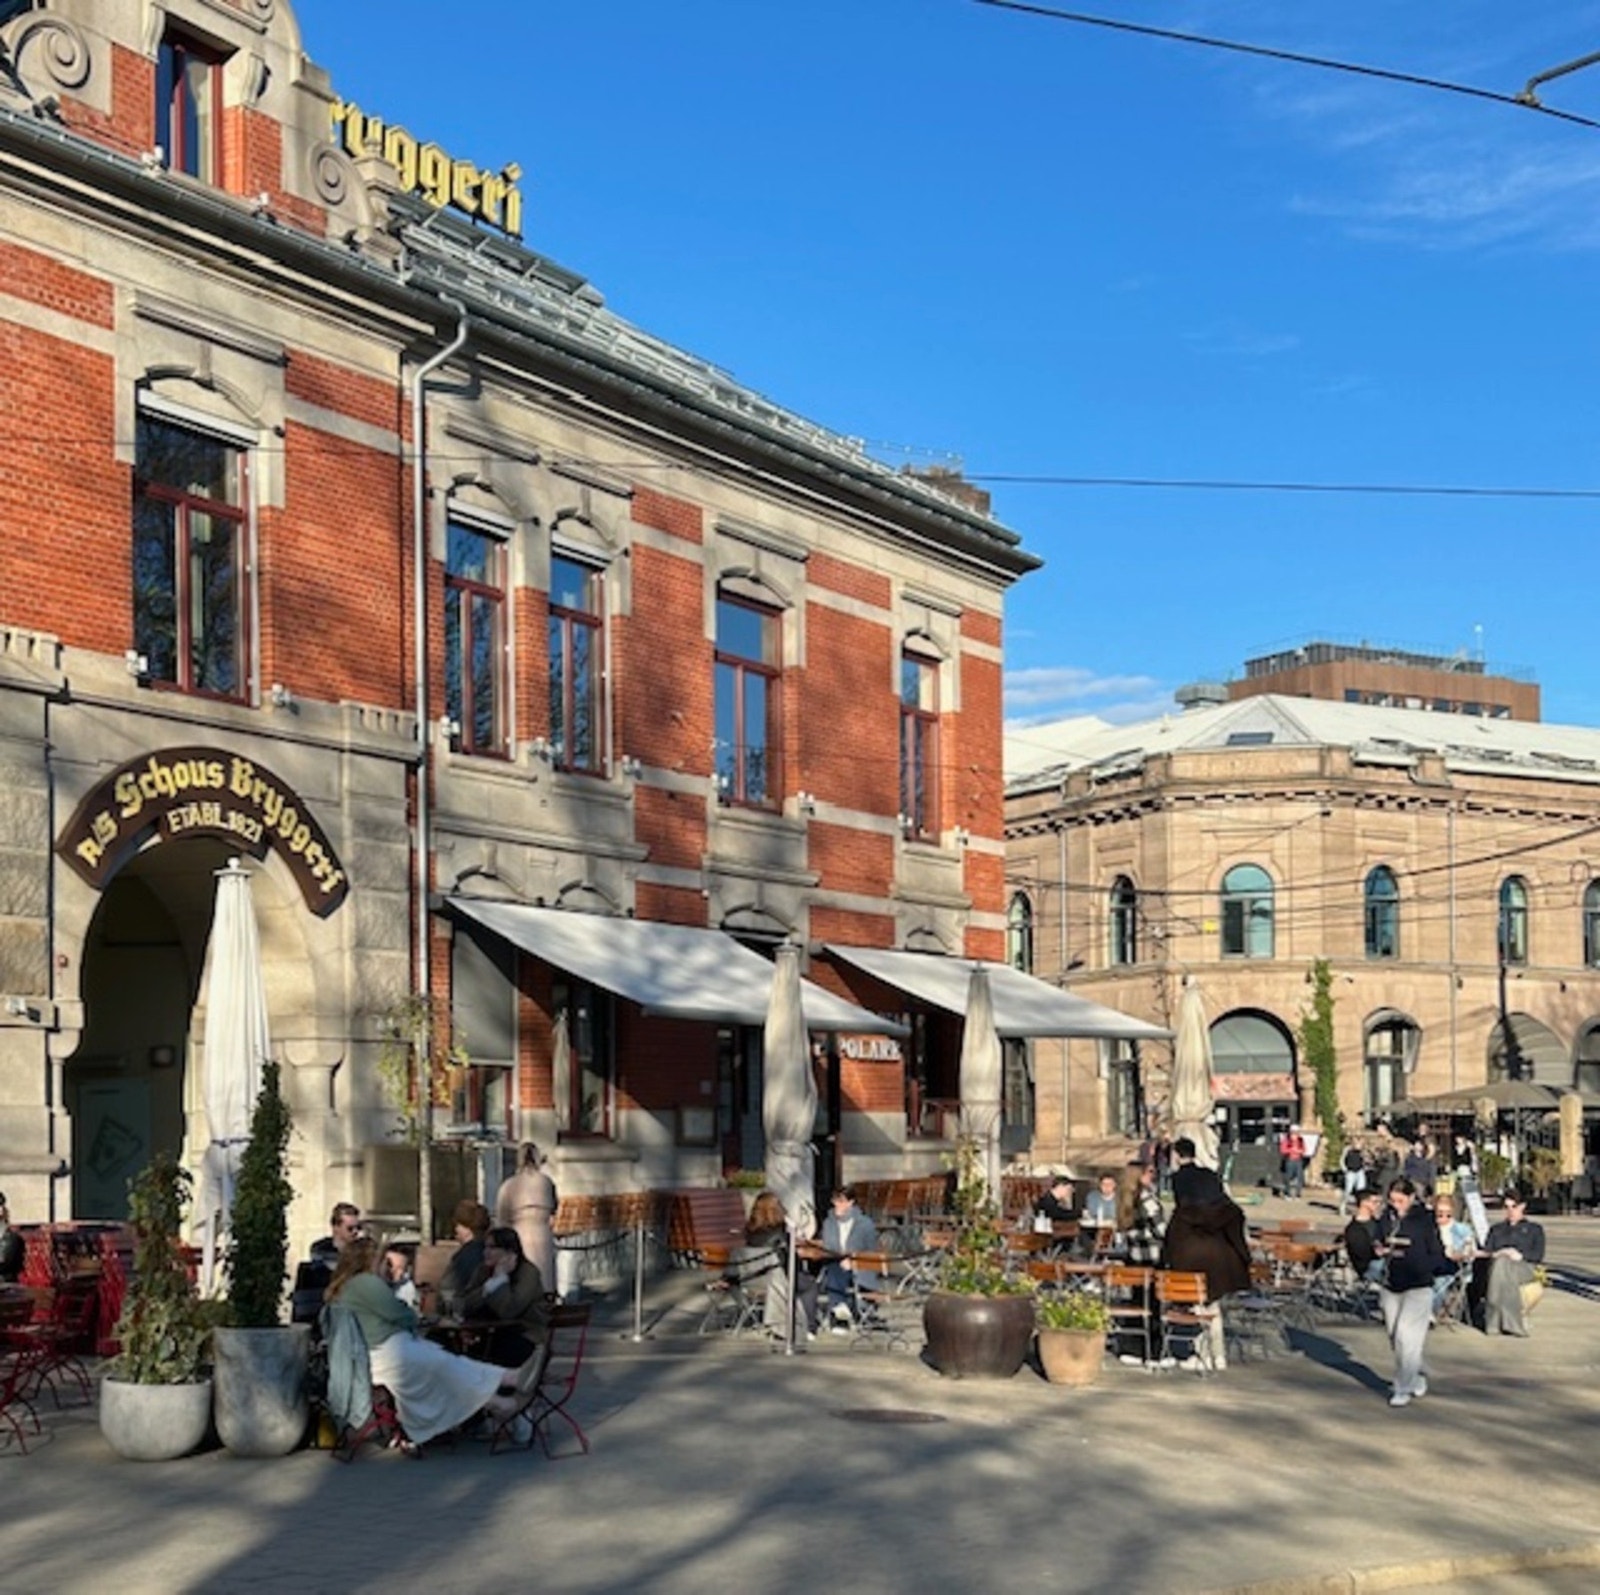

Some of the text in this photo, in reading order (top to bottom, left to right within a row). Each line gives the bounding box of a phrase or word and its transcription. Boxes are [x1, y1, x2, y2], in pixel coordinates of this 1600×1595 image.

[328, 96, 522, 235] ryggeri
[115, 757, 225, 818] Schous
[230, 758, 343, 893] Bryggeri
